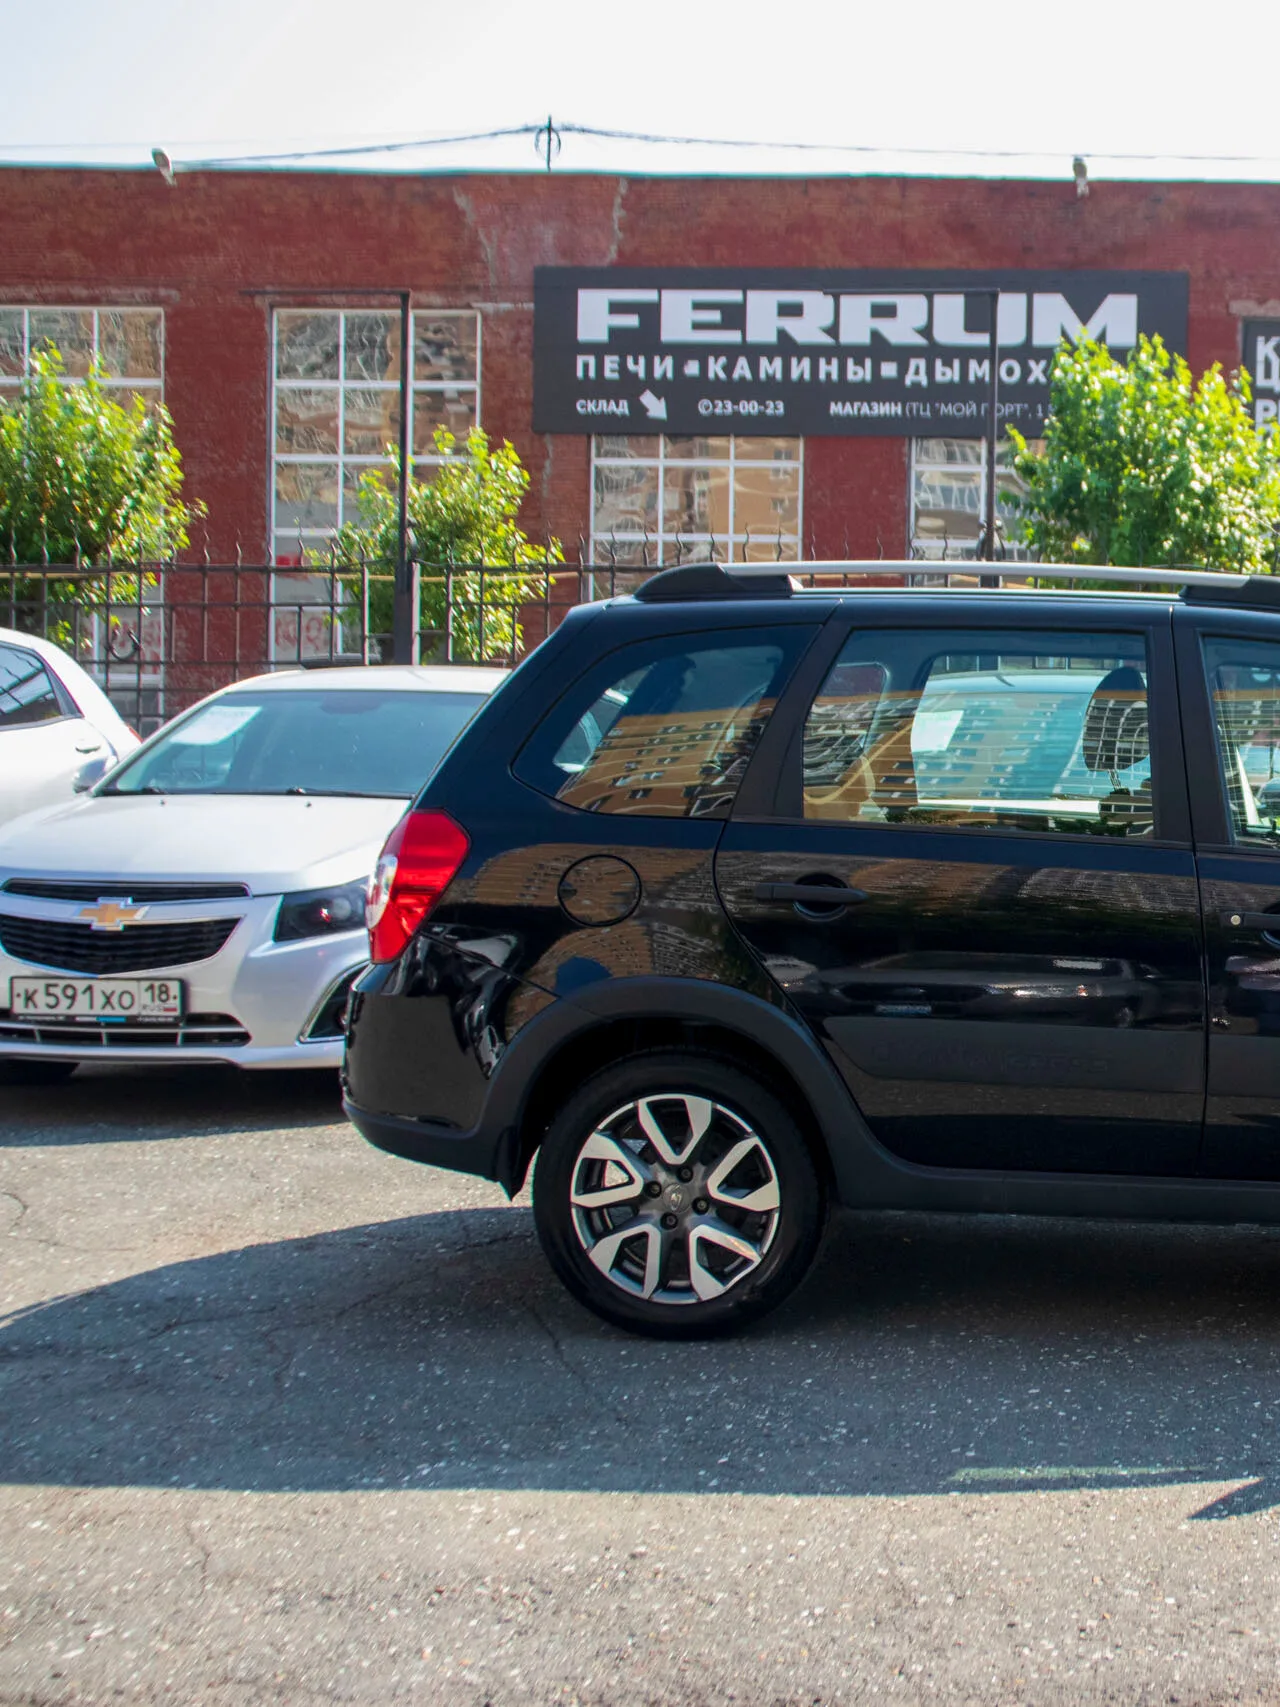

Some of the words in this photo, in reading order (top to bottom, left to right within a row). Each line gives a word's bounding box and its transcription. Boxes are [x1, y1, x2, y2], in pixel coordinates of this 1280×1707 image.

[577, 289, 1138, 347] FERRUM
[576, 355, 673, 380] ПЕЧИ
[708, 356, 872, 383] КАМИНЫ
[904, 358, 1048, 388] ДЫМОХ
[576, 399, 629, 417] СКЛАД
[829, 401, 902, 417] МАГАЗИН
[905, 402, 932, 418] (ТЦ
[144, 983, 170, 1003] 18
